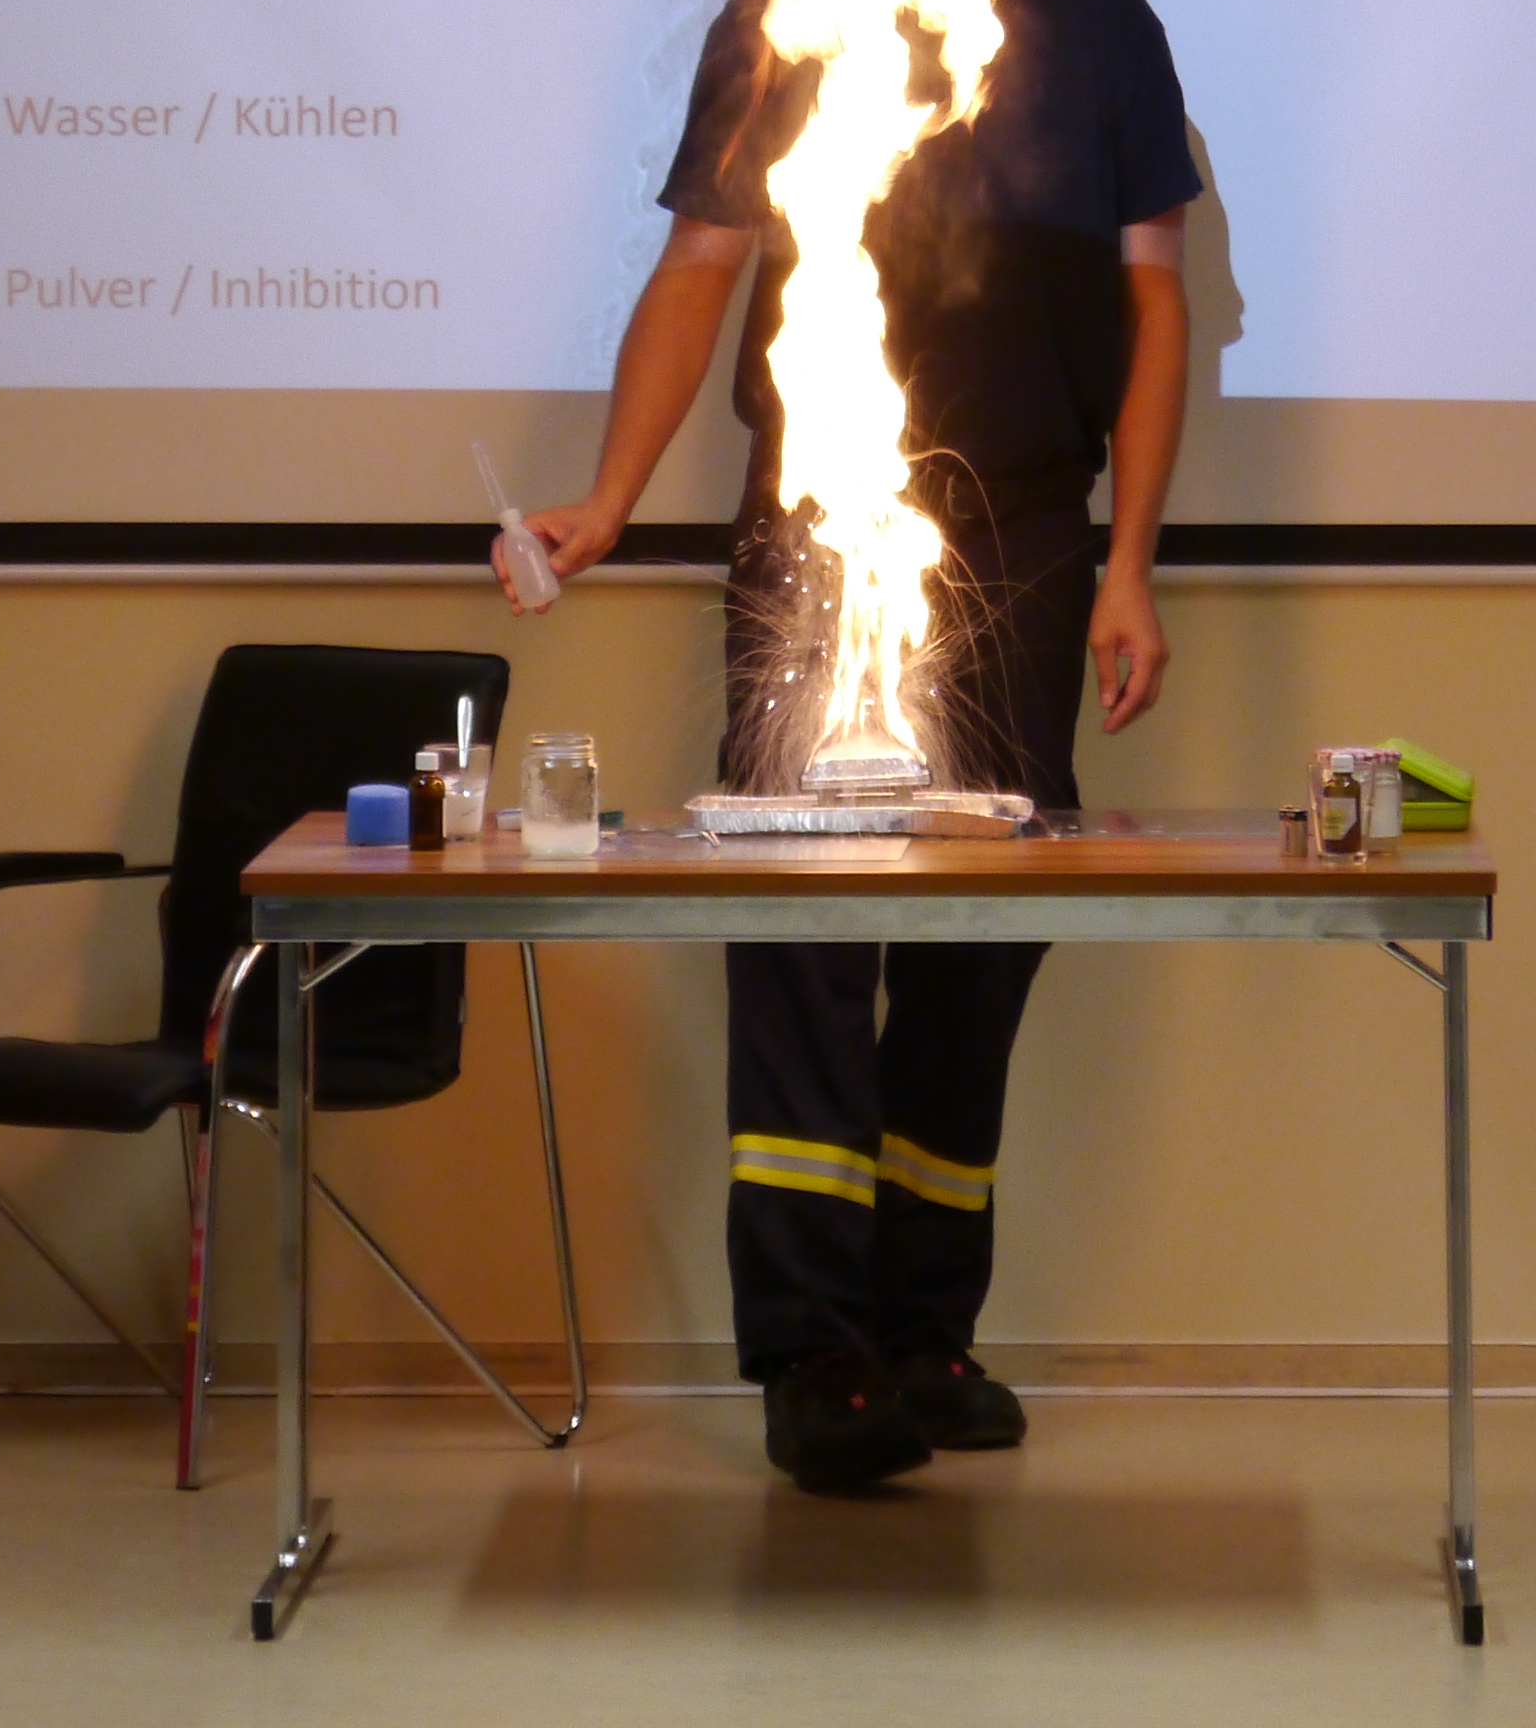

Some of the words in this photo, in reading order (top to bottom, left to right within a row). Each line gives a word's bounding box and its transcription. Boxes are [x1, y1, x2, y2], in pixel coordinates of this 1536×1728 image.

[4, 95, 181, 139] Wasser
[234, 94, 399, 140] Kühlen
[6, 265, 157, 311] Pulver
[211, 266, 441, 312] Inhibition
